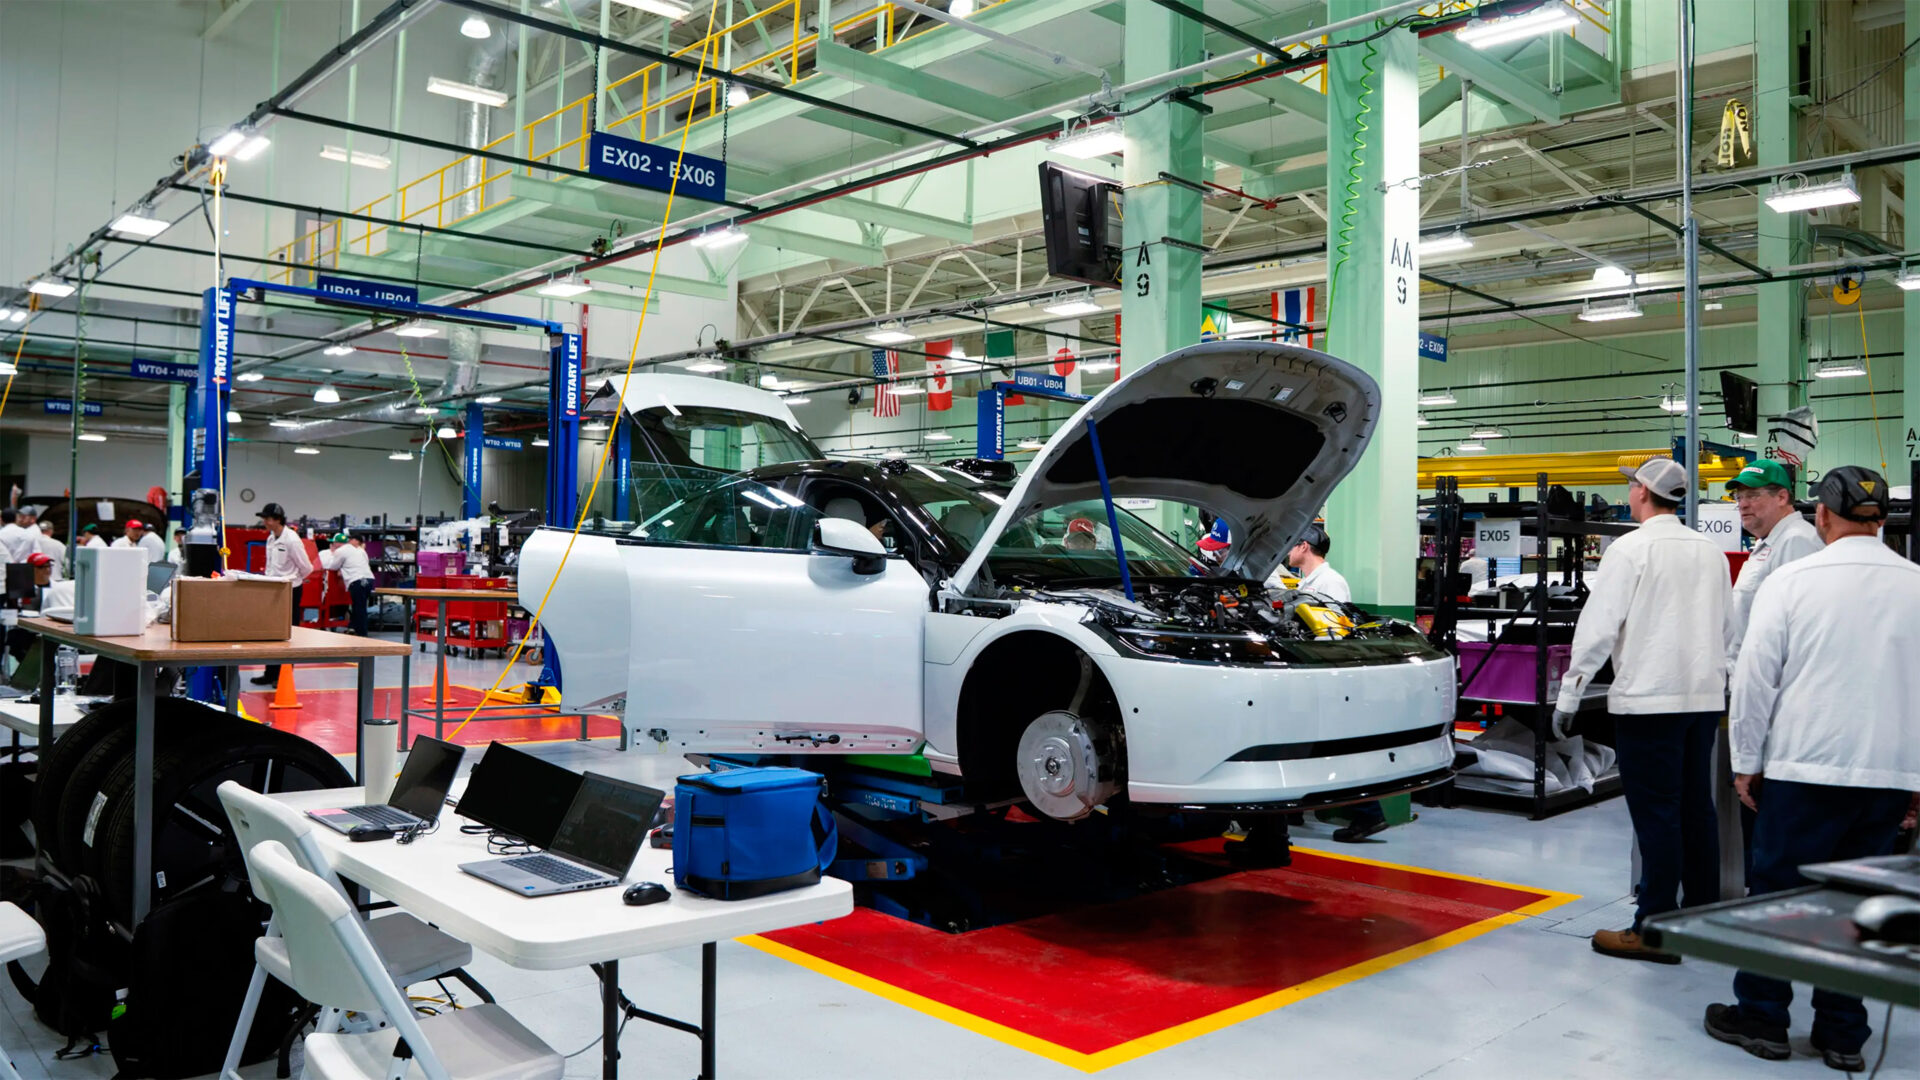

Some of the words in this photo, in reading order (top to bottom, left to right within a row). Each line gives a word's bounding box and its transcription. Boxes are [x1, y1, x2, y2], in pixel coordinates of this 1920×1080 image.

[602, 145, 651, 173] EX02
[669, 161, 716, 187] EX06
[1137, 241, 1150, 267] A
[1391, 238, 1413, 271] AA
[1137, 273, 1150, 297] 9
[1397, 276, 1406, 304] 9
[218, 289, 231, 319] LIFT
[214, 321, 229, 376] ROTARY
[569, 334, 578, 360] LIFT
[1428, 341, 1444, 354] EX06
[138, 364, 168, 376] WT04
[1017, 375, 1037, 386] UB01
[1044, 378, 1063, 390] UB04
[567, 362, 577, 409] ROTARY
[1768, 432, 1778, 443] A
[1480, 530, 1510, 541] EX05
[1697, 520, 1732, 533] EX06
